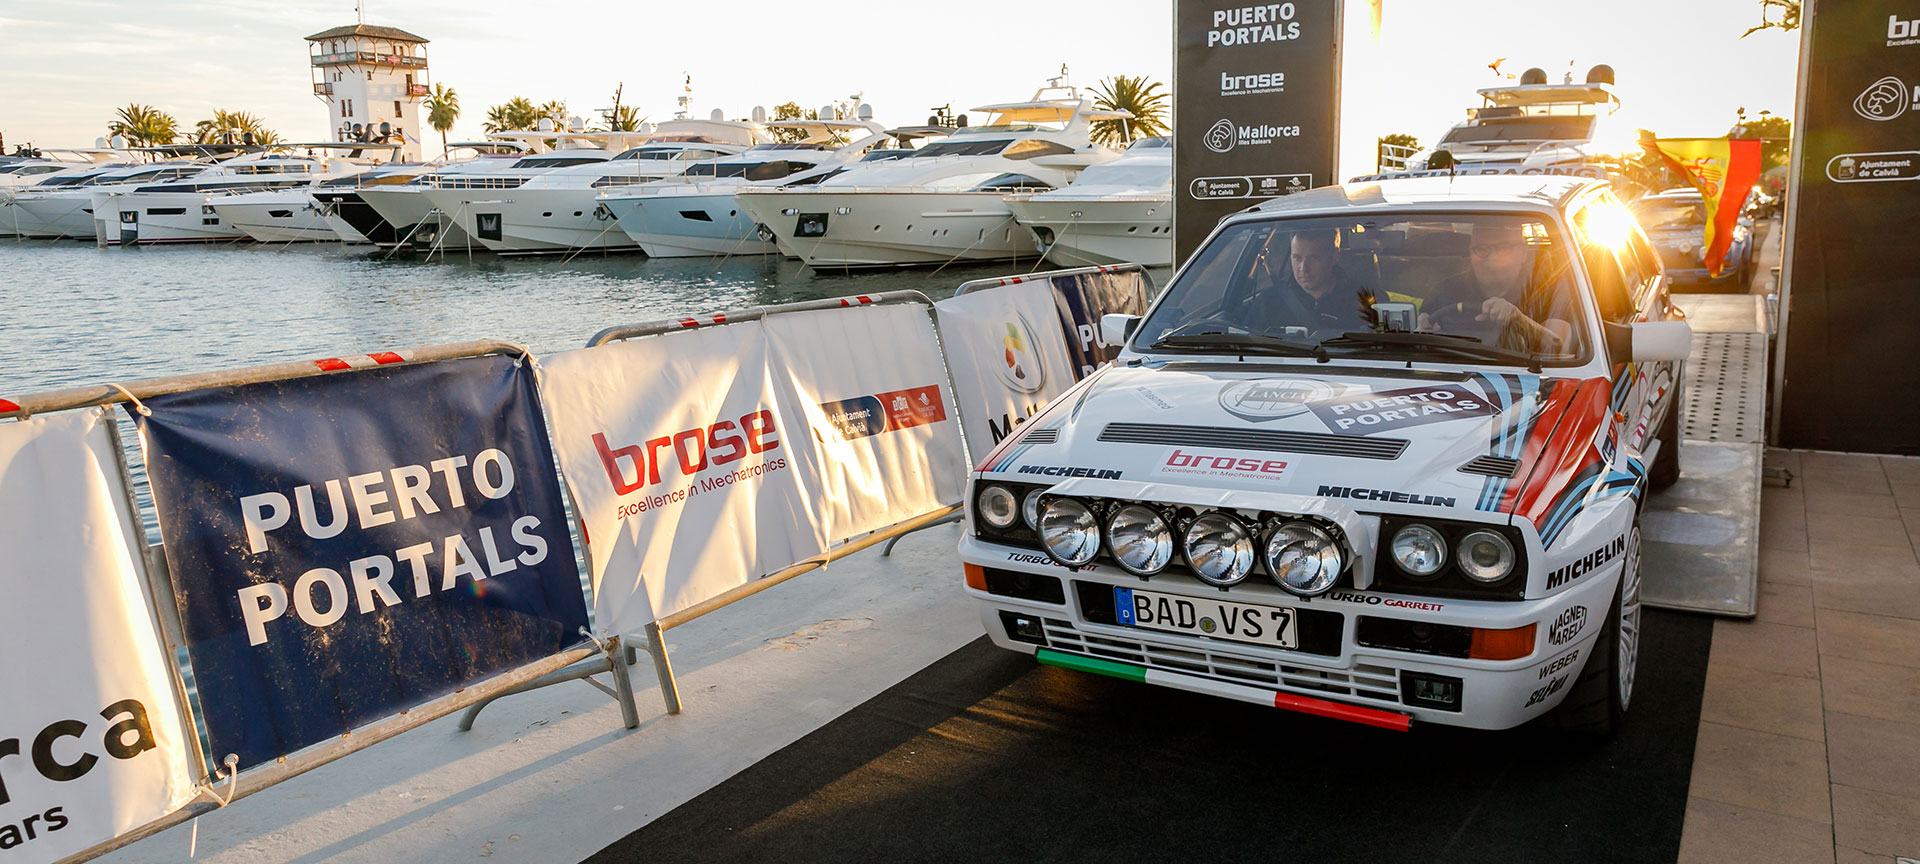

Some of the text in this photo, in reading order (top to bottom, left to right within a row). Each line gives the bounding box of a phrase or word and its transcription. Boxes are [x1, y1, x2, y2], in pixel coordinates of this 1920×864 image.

[1213, 2, 1295, 28] PUERTO
[1208, 22, 1300, 47] PORTALS
[1221, 72, 1284, 90] brose
[1238, 124, 1300, 139] Mallorca
[1859, 160, 1911, 169] Ajuntament
[1859, 168, 1899, 177] de Calvià
[1209, 182, 1240, 190] Ajuntament
[1249, 390, 1307, 400] LANCIA
[1330, 390, 1455, 416] PUERTO
[831, 408, 871, 426] Ajuntament
[1334, 400, 1481, 430] PORTALS
[591, 409, 780, 496] brose
[1166, 450, 1288, 474] brose
[1017, 465, 1123, 480] MICHELIN
[1161, 467, 1207, 475] Excellence
[1219, 471, 1280, 481] Mechatronics
[617, 457, 786, 520] Excellence in Mechatronics
[1316, 485, 1456, 507] MICHELIN
[240, 448, 515, 554] PUERTO
[1007, 552, 1052, 565] TURBO
[1546, 534, 1625, 590] MICHELIN
[237, 515, 549, 646] PORTALS
[1321, 591, 1444, 612] TURBO GARRETT
[1122, 594, 1291, 641] D BAD VS 7
[1539, 649, 1579, 680] WEBER
